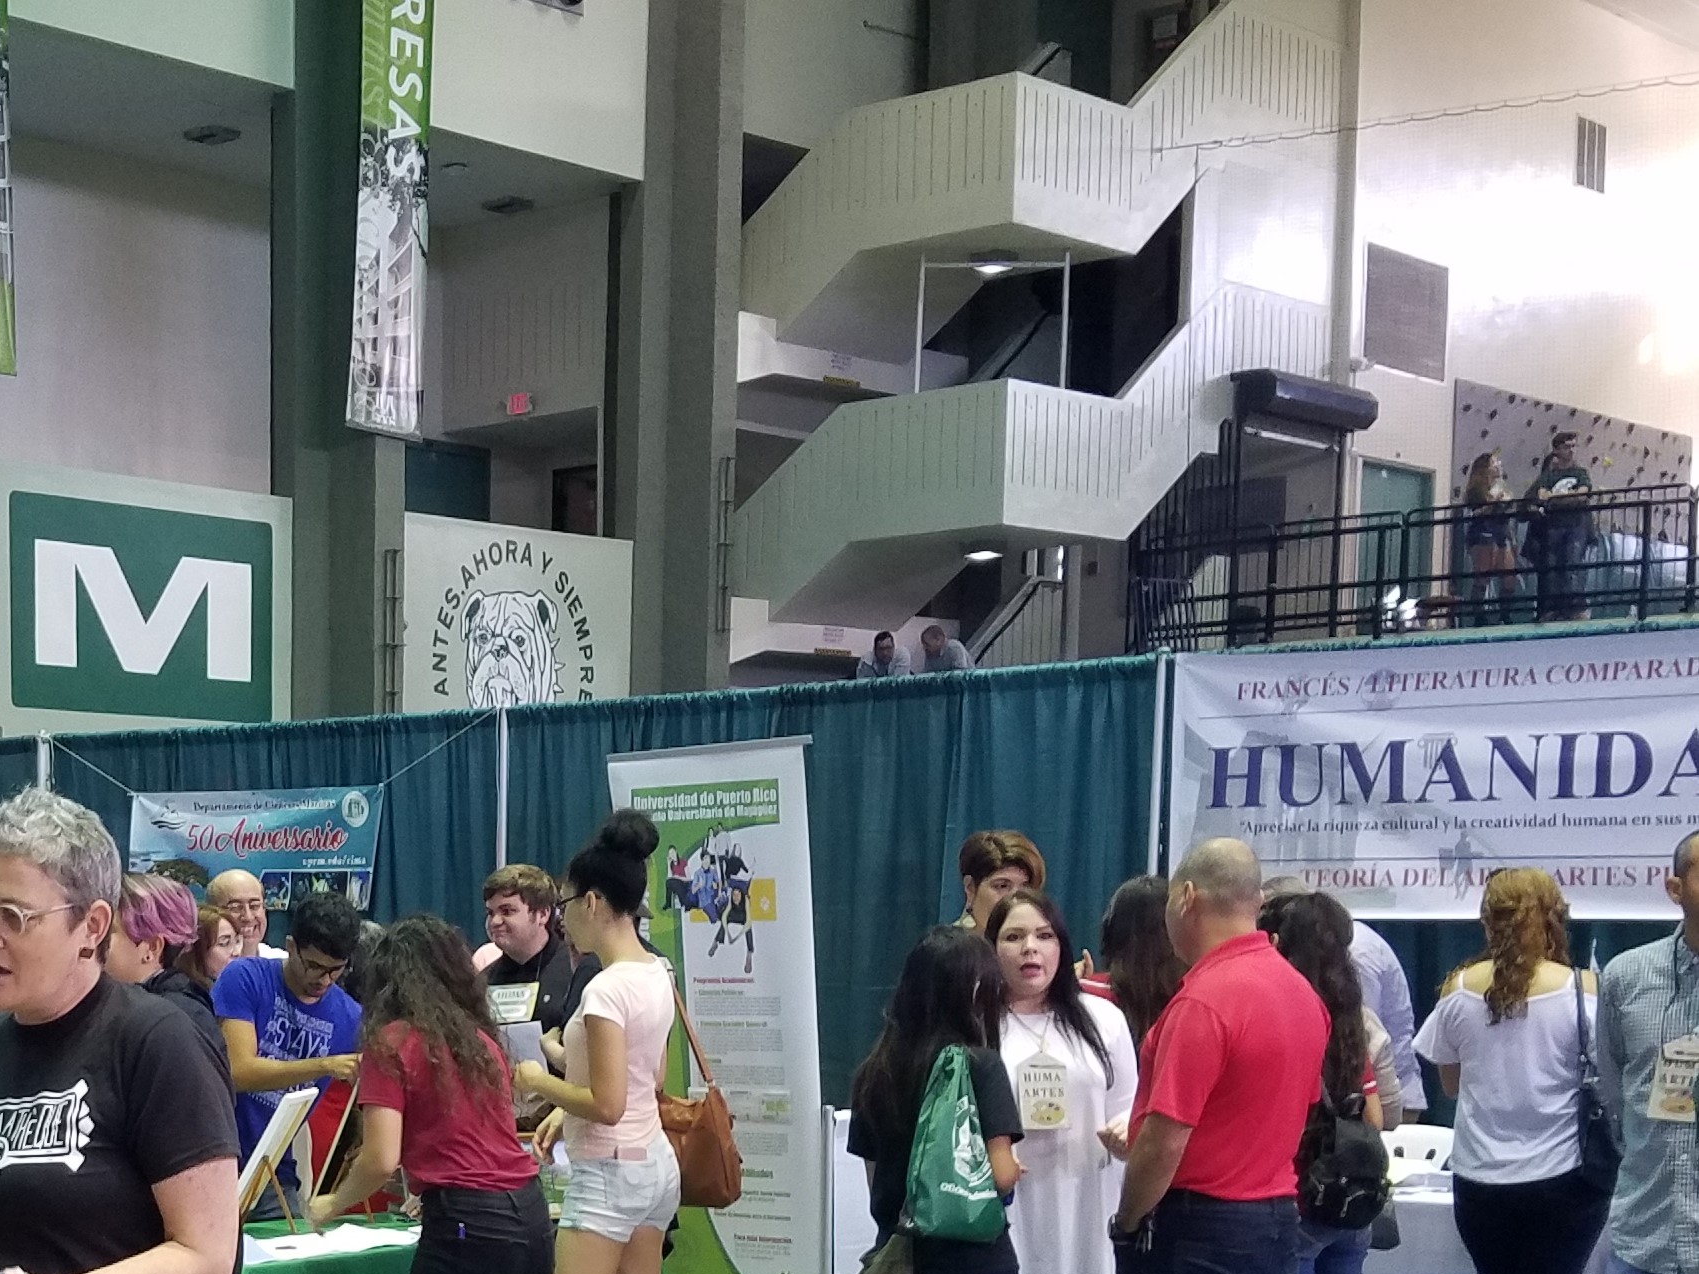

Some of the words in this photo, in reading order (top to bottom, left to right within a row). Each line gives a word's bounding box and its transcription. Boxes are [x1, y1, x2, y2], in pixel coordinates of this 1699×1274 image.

[35, 538, 252, 683] M
[460, 539, 533, 589] AHORA
[542, 551, 554, 575] Y
[554, 571, 595, 701] SIEMPRE
[1237, 670, 1351, 701] FRANCÉS
[1370, 665, 1538, 694] LITERATURA
[1205, 727, 1699, 810] HUMANIDA
[633, 791, 699, 811] Universidad
[716, 789, 752, 806] Puerto
[753, 787, 777, 803] Rico
[186, 823, 215, 852] 50
[214, 817, 348, 858] Aniversario
[1470, 811, 1558, 829] creatividad
[1561, 812, 1628, 828] humana
[1302, 862, 1396, 888] TEORÍA
[275, 1016, 322, 1060] STAY
[1023, 1072, 1062, 1083] HUMA
[1023, 1087, 1065, 1099] ARTES
